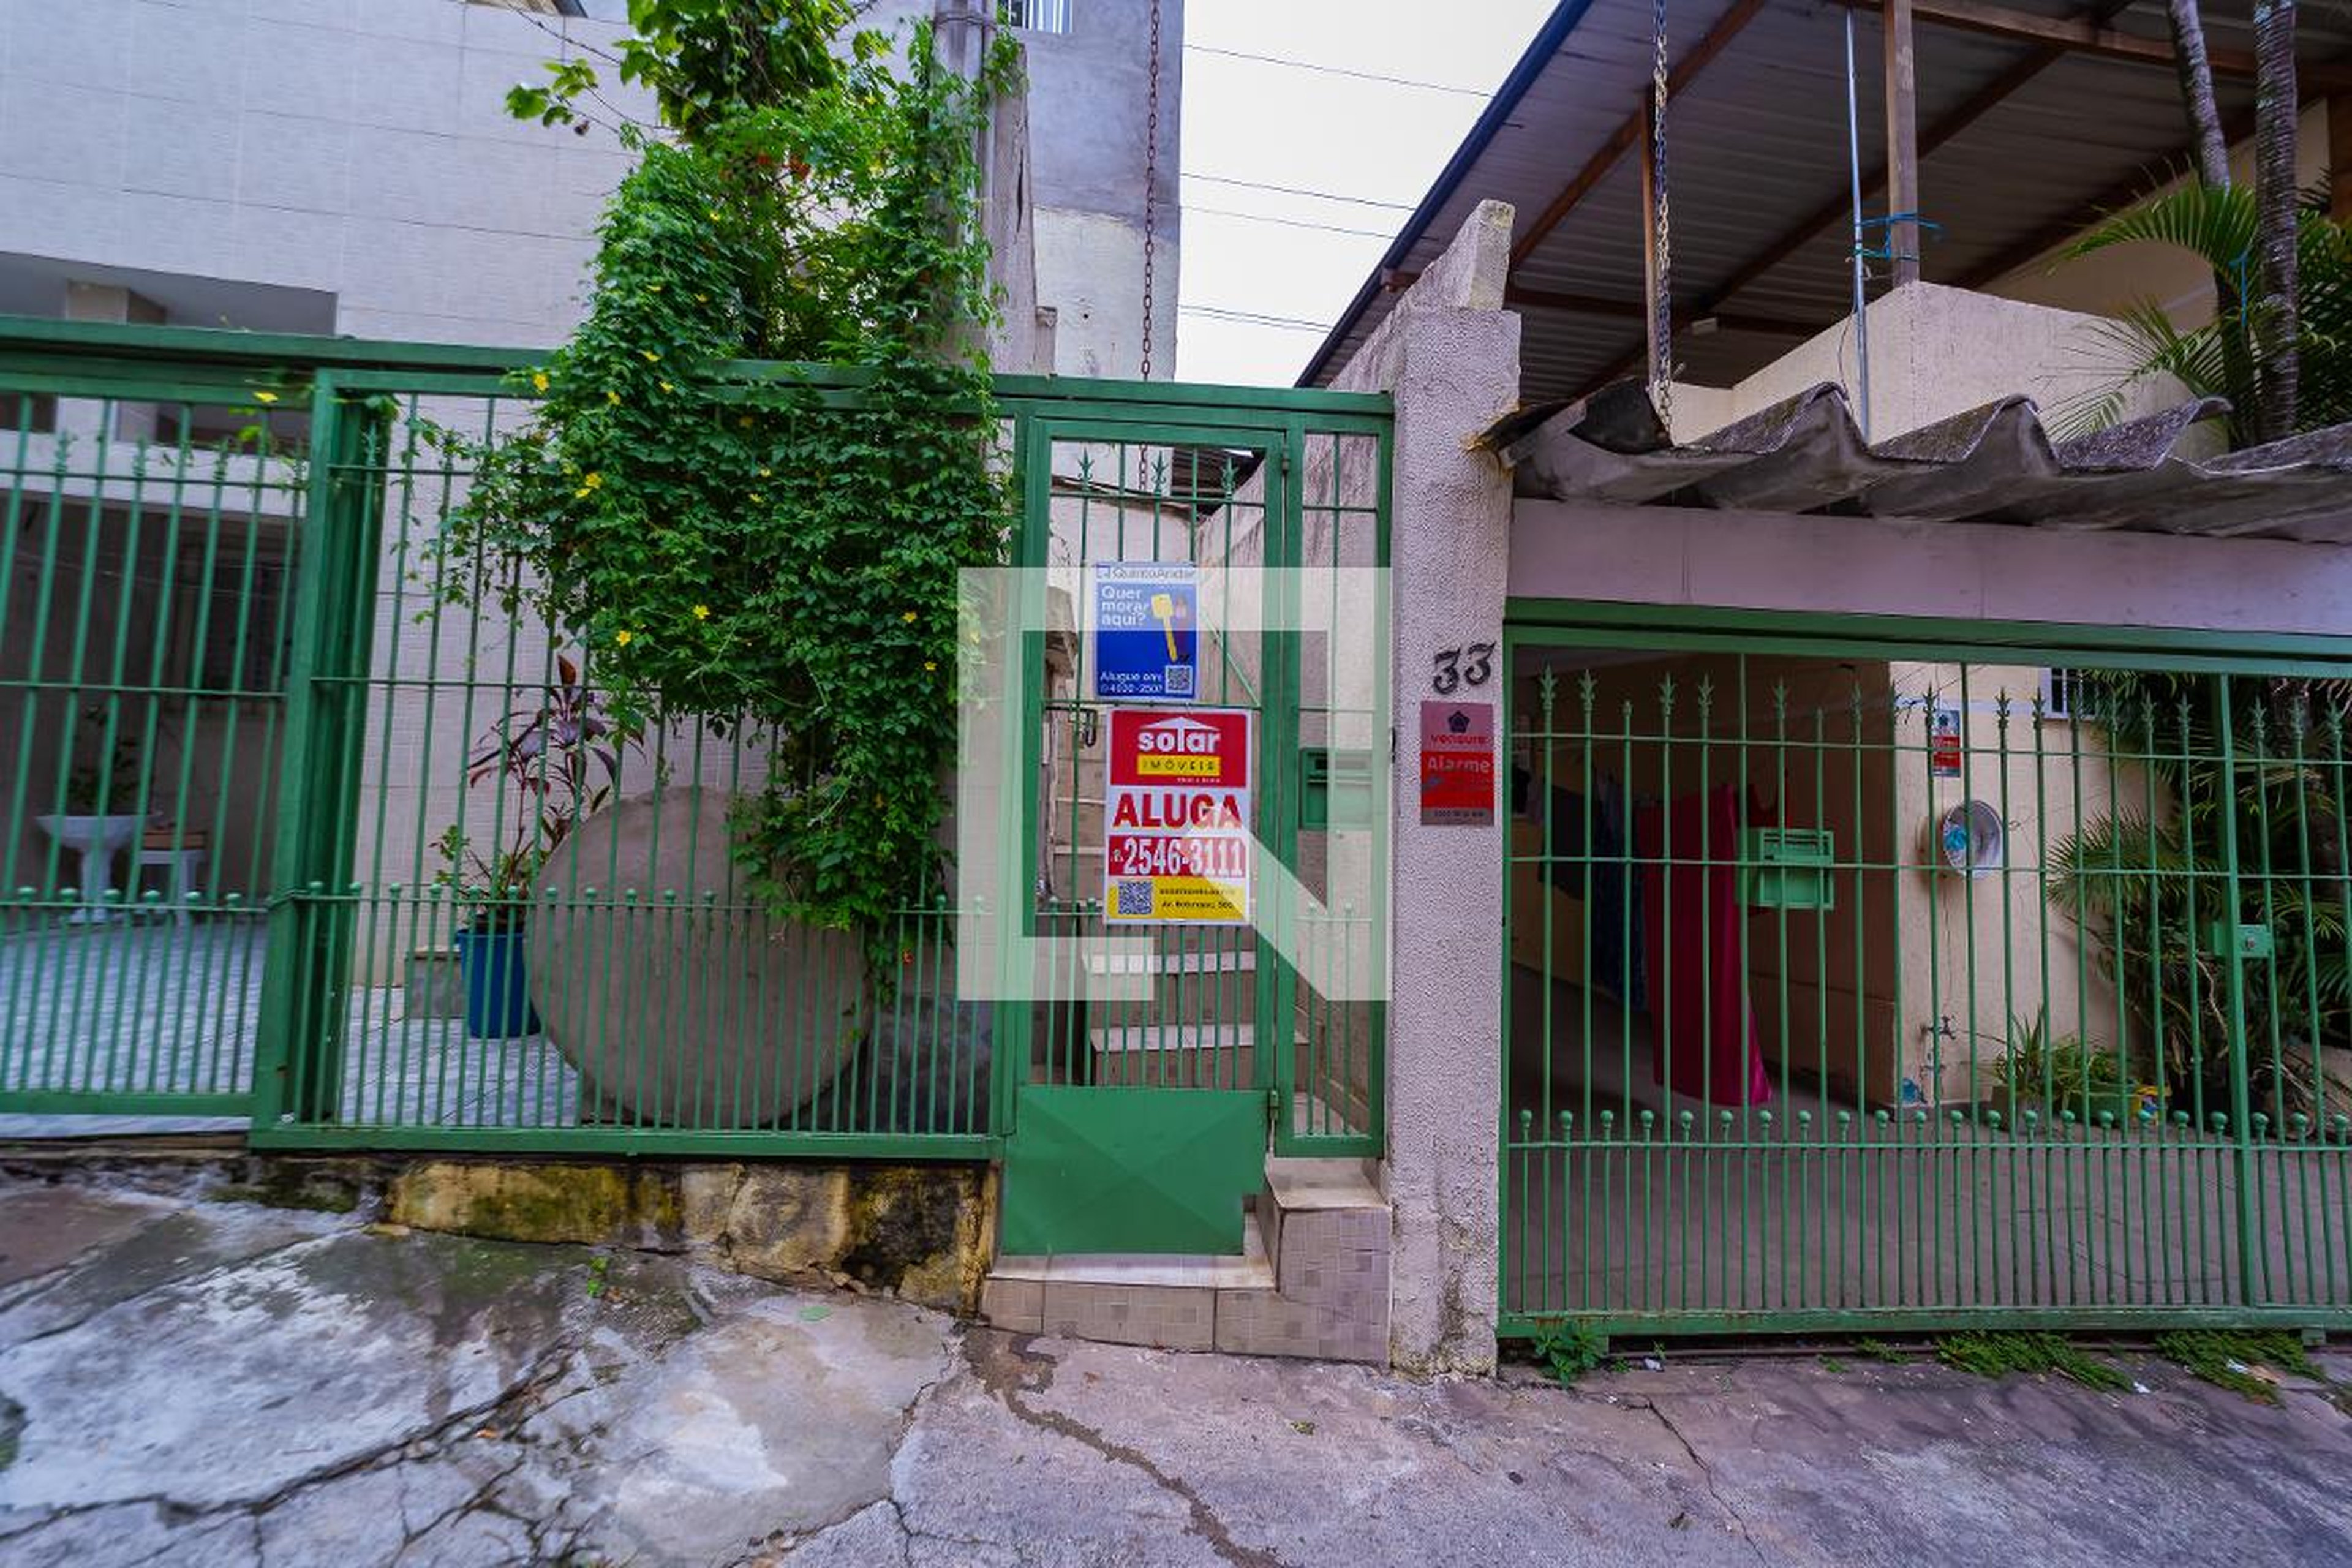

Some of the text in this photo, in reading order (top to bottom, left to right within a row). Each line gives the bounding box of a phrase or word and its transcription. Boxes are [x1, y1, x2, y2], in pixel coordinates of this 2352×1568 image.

[1102, 586, 1142, 601] Quer
[1102, 601, 1149, 612] morar
[1102, 612, 1147, 627] aqui?
[1433, 641, 1497, 695] 33
[1137, 728, 1221, 753] solar
[1428, 755, 1491, 774] Alarme
[1112, 793, 1242, 829] ALUGA
[1123, 837, 1243, 876] 2546-3111
